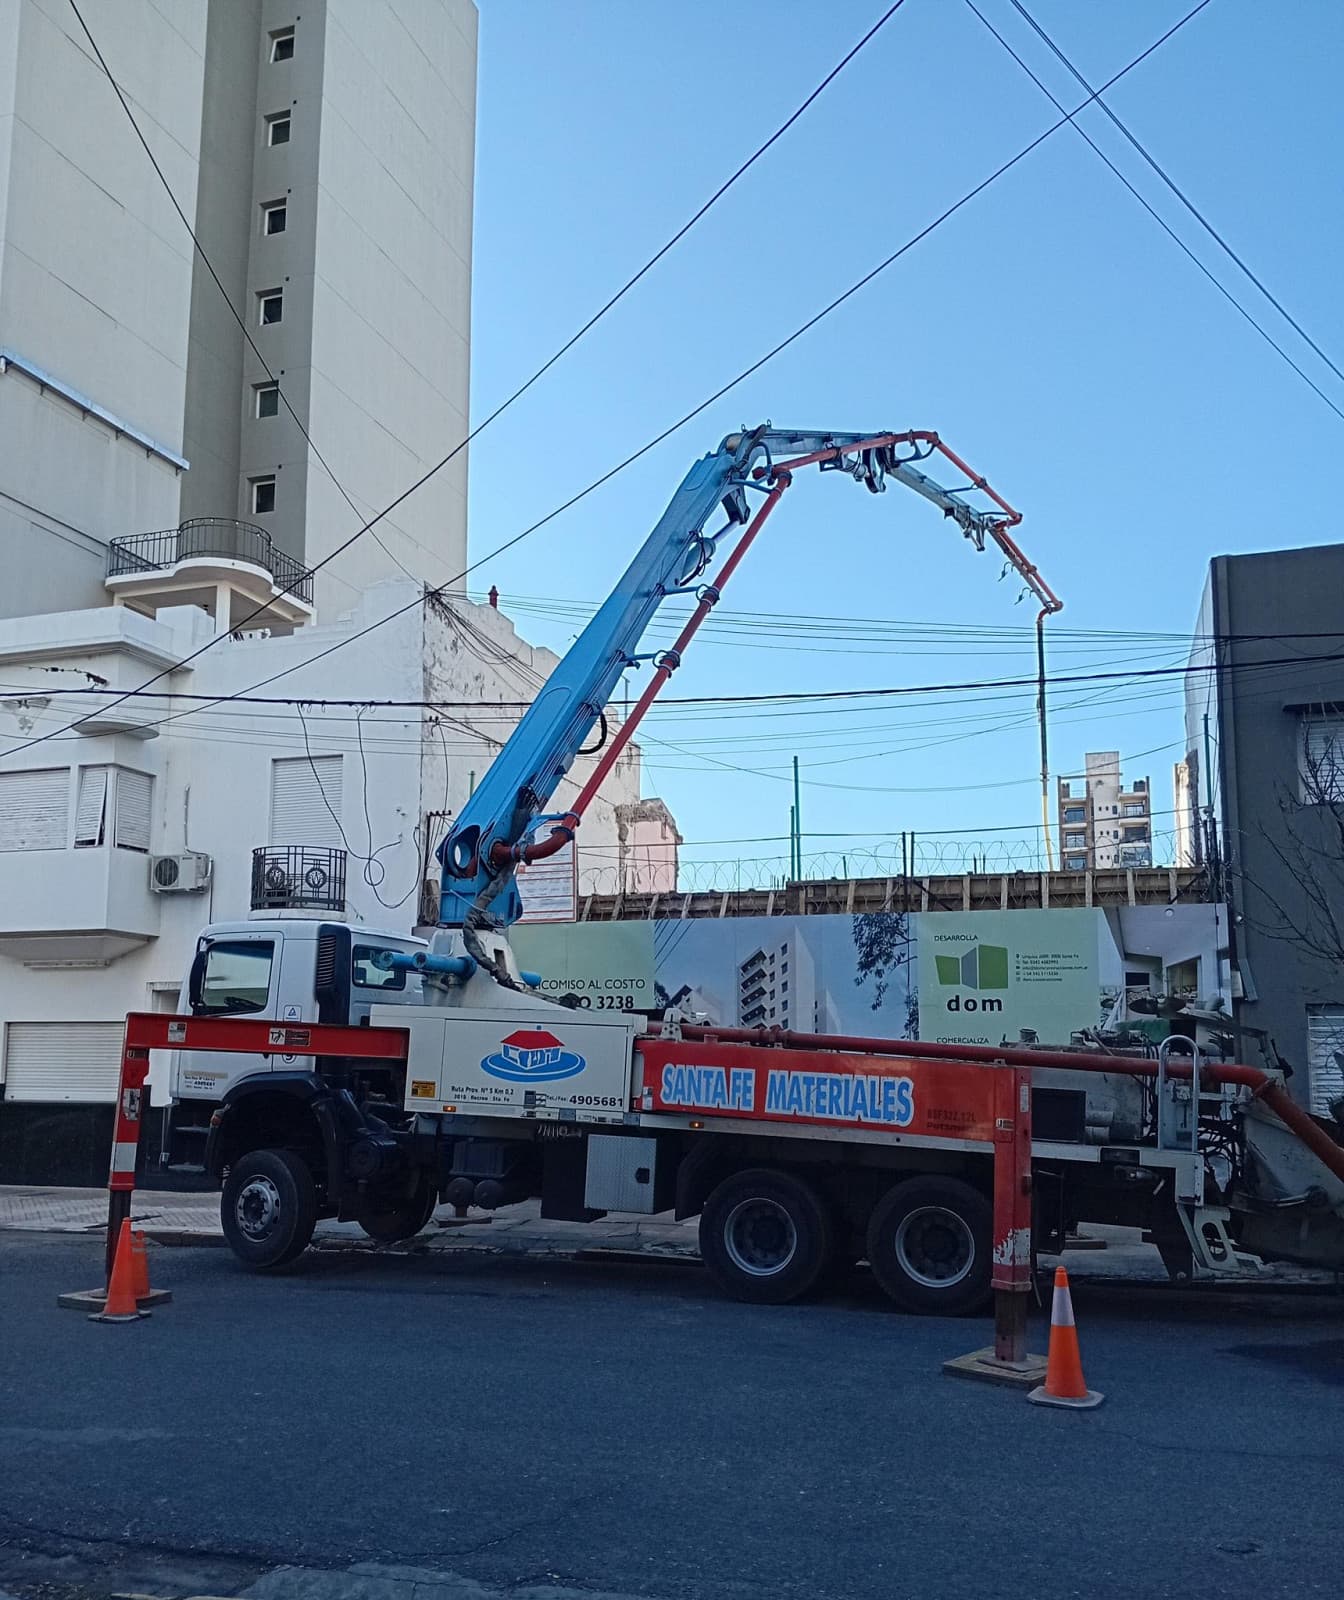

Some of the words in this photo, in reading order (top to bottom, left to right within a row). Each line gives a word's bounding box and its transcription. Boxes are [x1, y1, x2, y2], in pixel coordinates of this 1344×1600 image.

[934, 934, 978, 942] DESARROLLA
[588, 979, 602, 990] AL
[604, 978, 646, 990] COSTO
[596, 995, 635, 1010] 3238
[946, 994, 1003, 1012] dom
[936, 1036, 990, 1045] COMERCIALIZA
[569, 1095, 623, 1107] 4905681
[765, 1069, 914, 1127] MATERIALES
